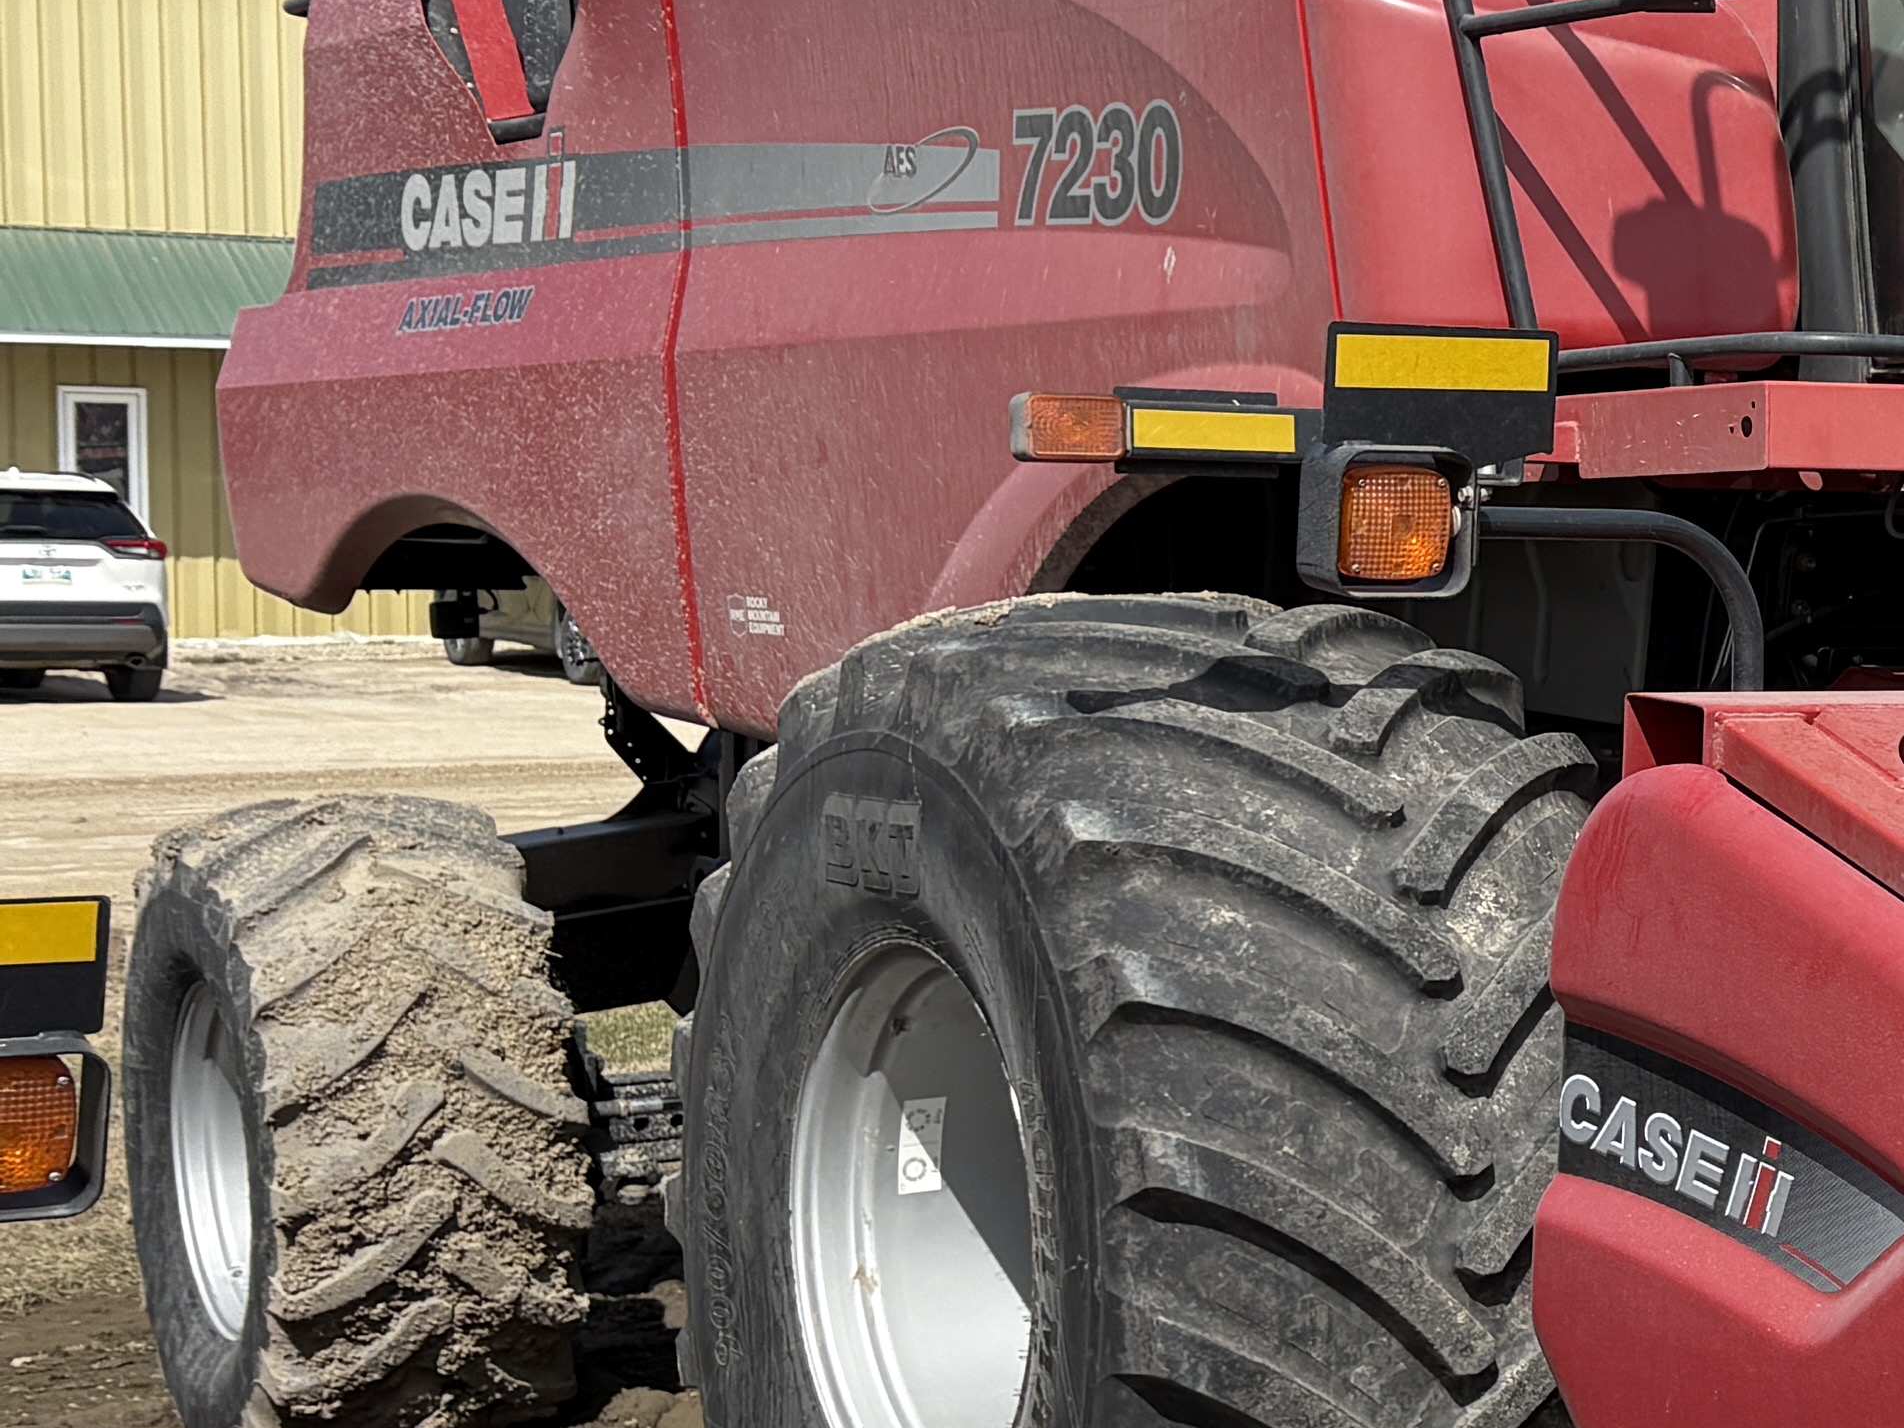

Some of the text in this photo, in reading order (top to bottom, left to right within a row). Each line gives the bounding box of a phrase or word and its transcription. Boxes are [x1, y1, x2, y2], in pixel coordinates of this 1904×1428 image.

[401, 168, 526, 251] CASE
[1013, 98, 1183, 226] 7230
[397, 285, 535, 335] AXIAL-FLOW
[1560, 1074, 1730, 1211] CASE
